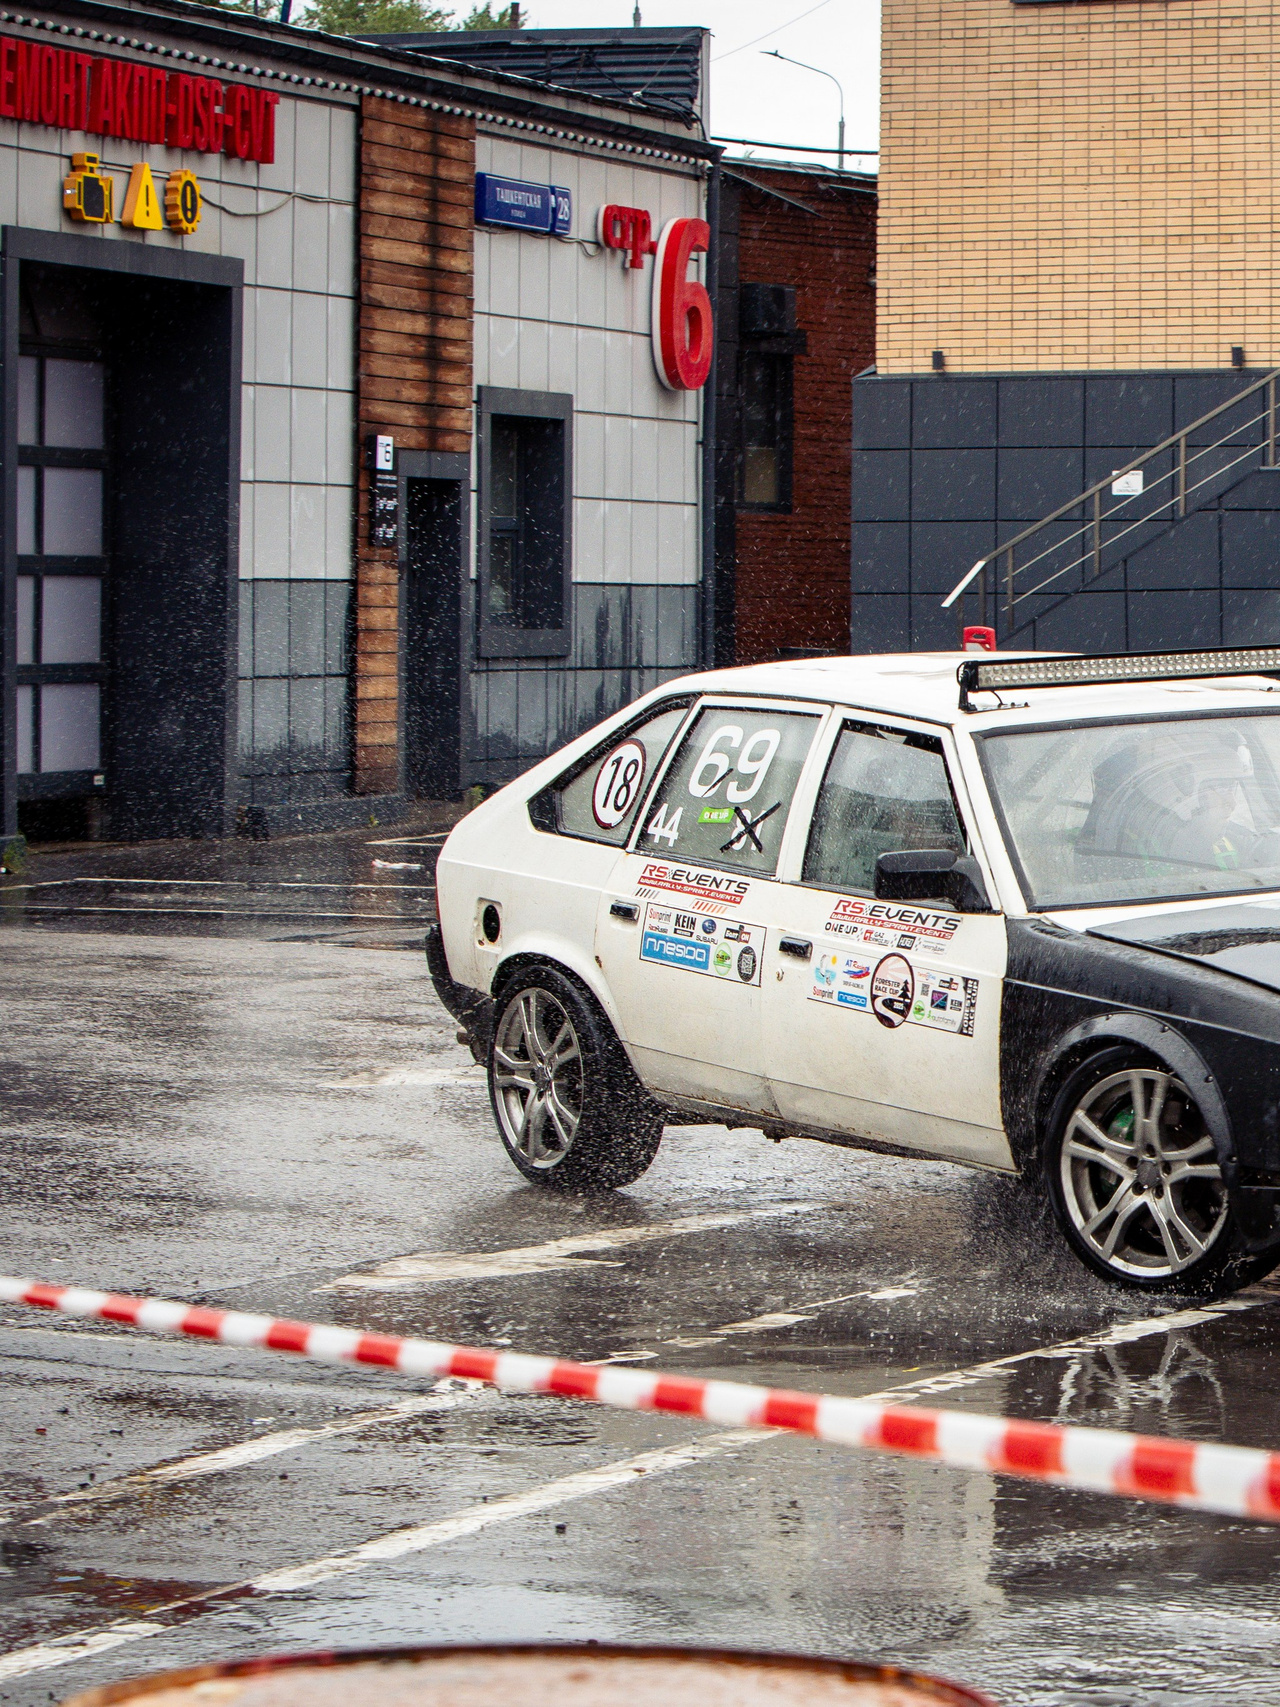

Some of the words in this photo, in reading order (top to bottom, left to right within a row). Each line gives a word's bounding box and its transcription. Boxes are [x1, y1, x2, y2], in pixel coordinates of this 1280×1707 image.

[496, 187, 542, 209] ТАШКЕНТСКАЯ
[558, 197, 570, 221] 28
[652, 217, 714, 392] 6
[384, 443, 392, 463] 6
[688, 725, 781, 804] 69
[602, 756, 639, 812] 18
[648, 803, 683, 847] 44
[671, 869, 751, 894] EVENTS
[675, 913, 697, 931] KEIN
[825, 922, 844, 934] ONE
[869, 905, 960, 930] EVENTS
[696, 934, 718, 945] SUBARU
[874, 985, 888, 994] RACE
[875, 978, 901, 988] FORESTER
[962, 979, 973, 1034] FORESTER
